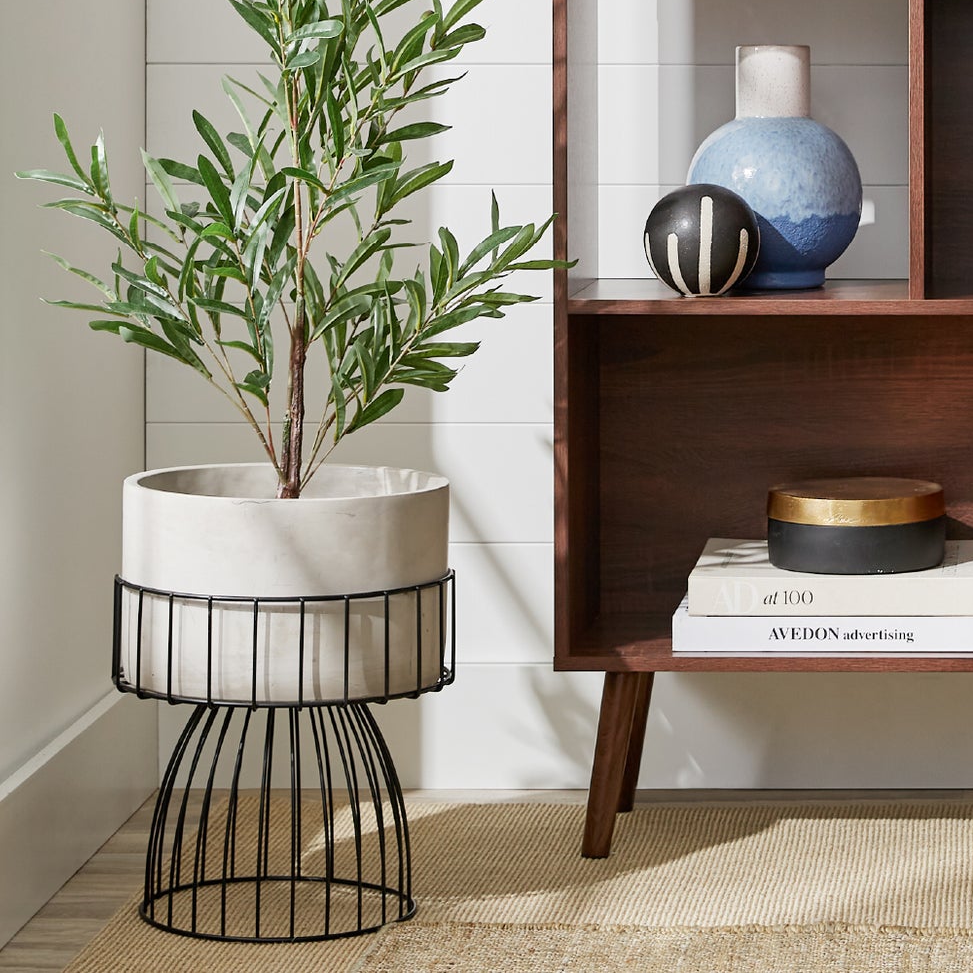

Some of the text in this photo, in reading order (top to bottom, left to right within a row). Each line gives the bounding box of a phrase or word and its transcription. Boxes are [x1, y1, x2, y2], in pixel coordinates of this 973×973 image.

[763, 591, 778, 605] at
[783, 590, 814, 605] 100
[769, 627, 915, 643] AVEDON advertising
